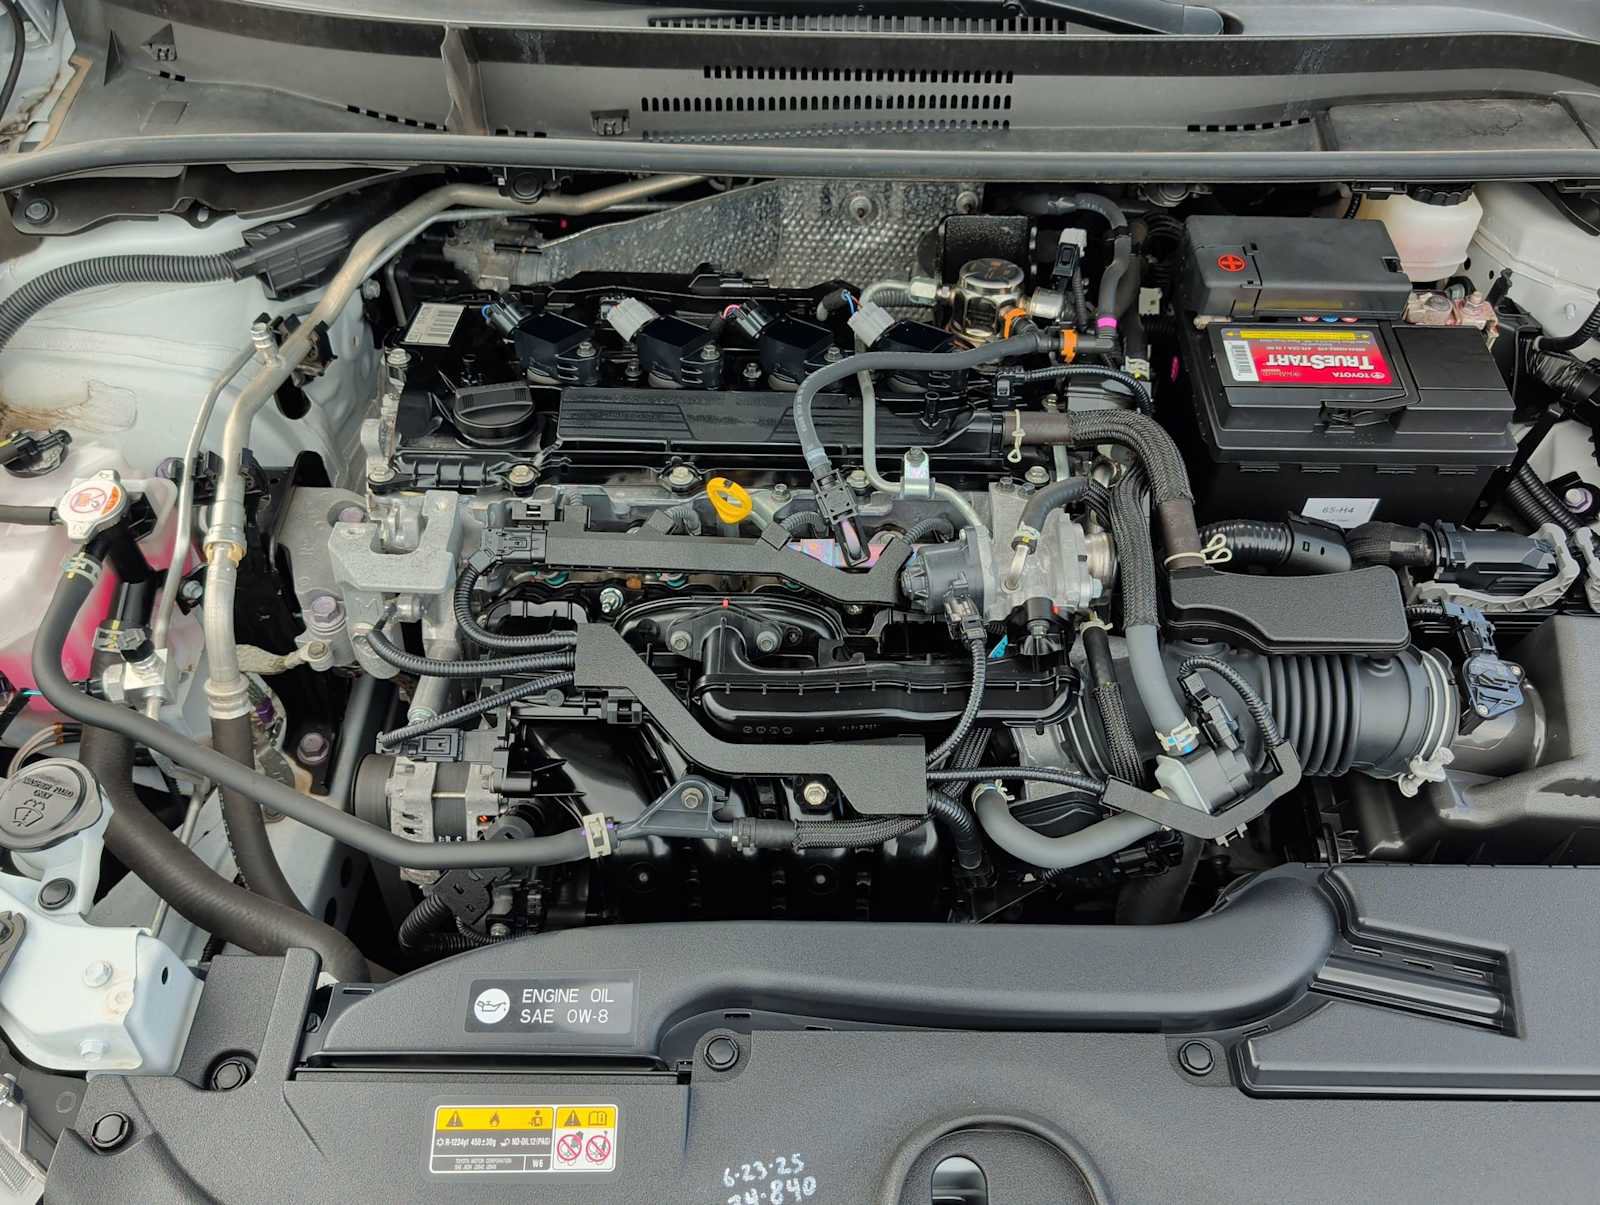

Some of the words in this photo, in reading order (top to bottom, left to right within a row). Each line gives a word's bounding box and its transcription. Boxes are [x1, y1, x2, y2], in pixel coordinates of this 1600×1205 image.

[522, 988, 580, 1004] ENGINE
[590, 988, 616, 1003] OIL
[519, 1009, 555, 1024] SAE
[567, 1009, 609, 1024] 0W-8
